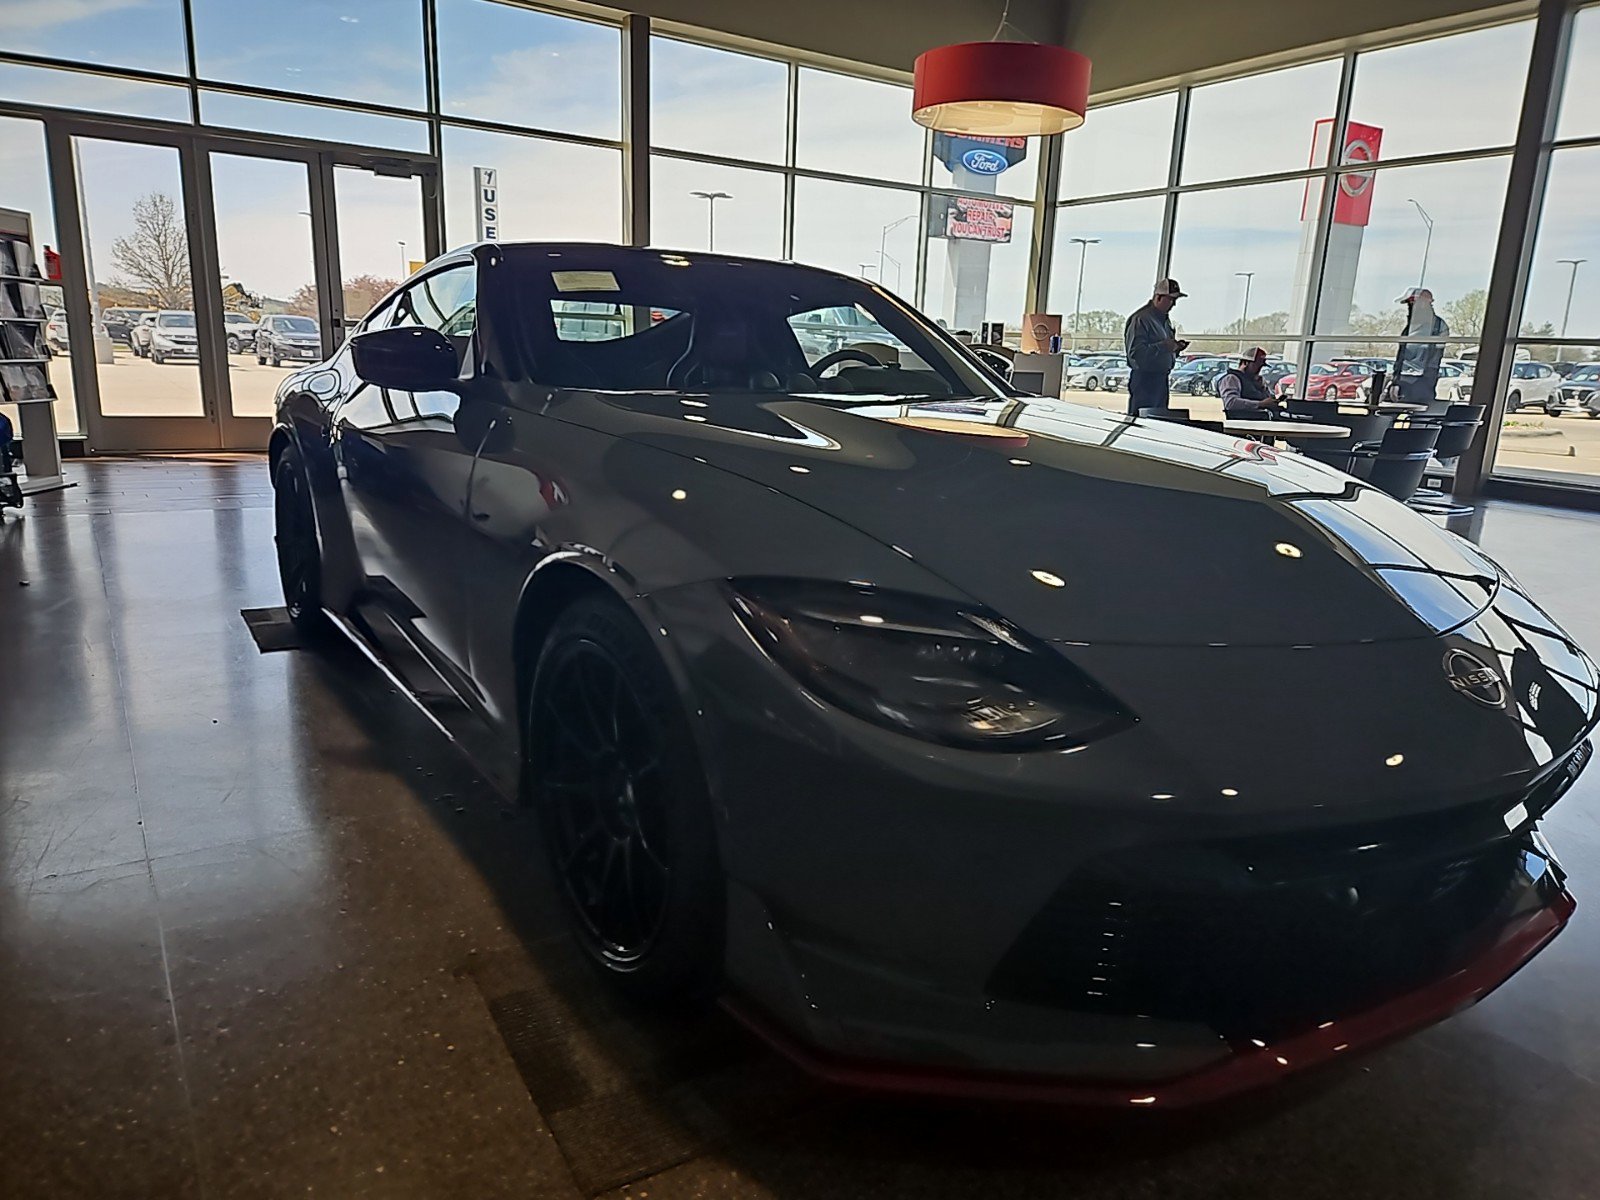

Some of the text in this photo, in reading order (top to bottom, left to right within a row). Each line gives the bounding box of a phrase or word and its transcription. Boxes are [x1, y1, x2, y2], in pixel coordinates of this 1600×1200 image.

[970, 152, 1000, 172] Ford
[952, 222, 1005, 239] YOU CAN TRUST
